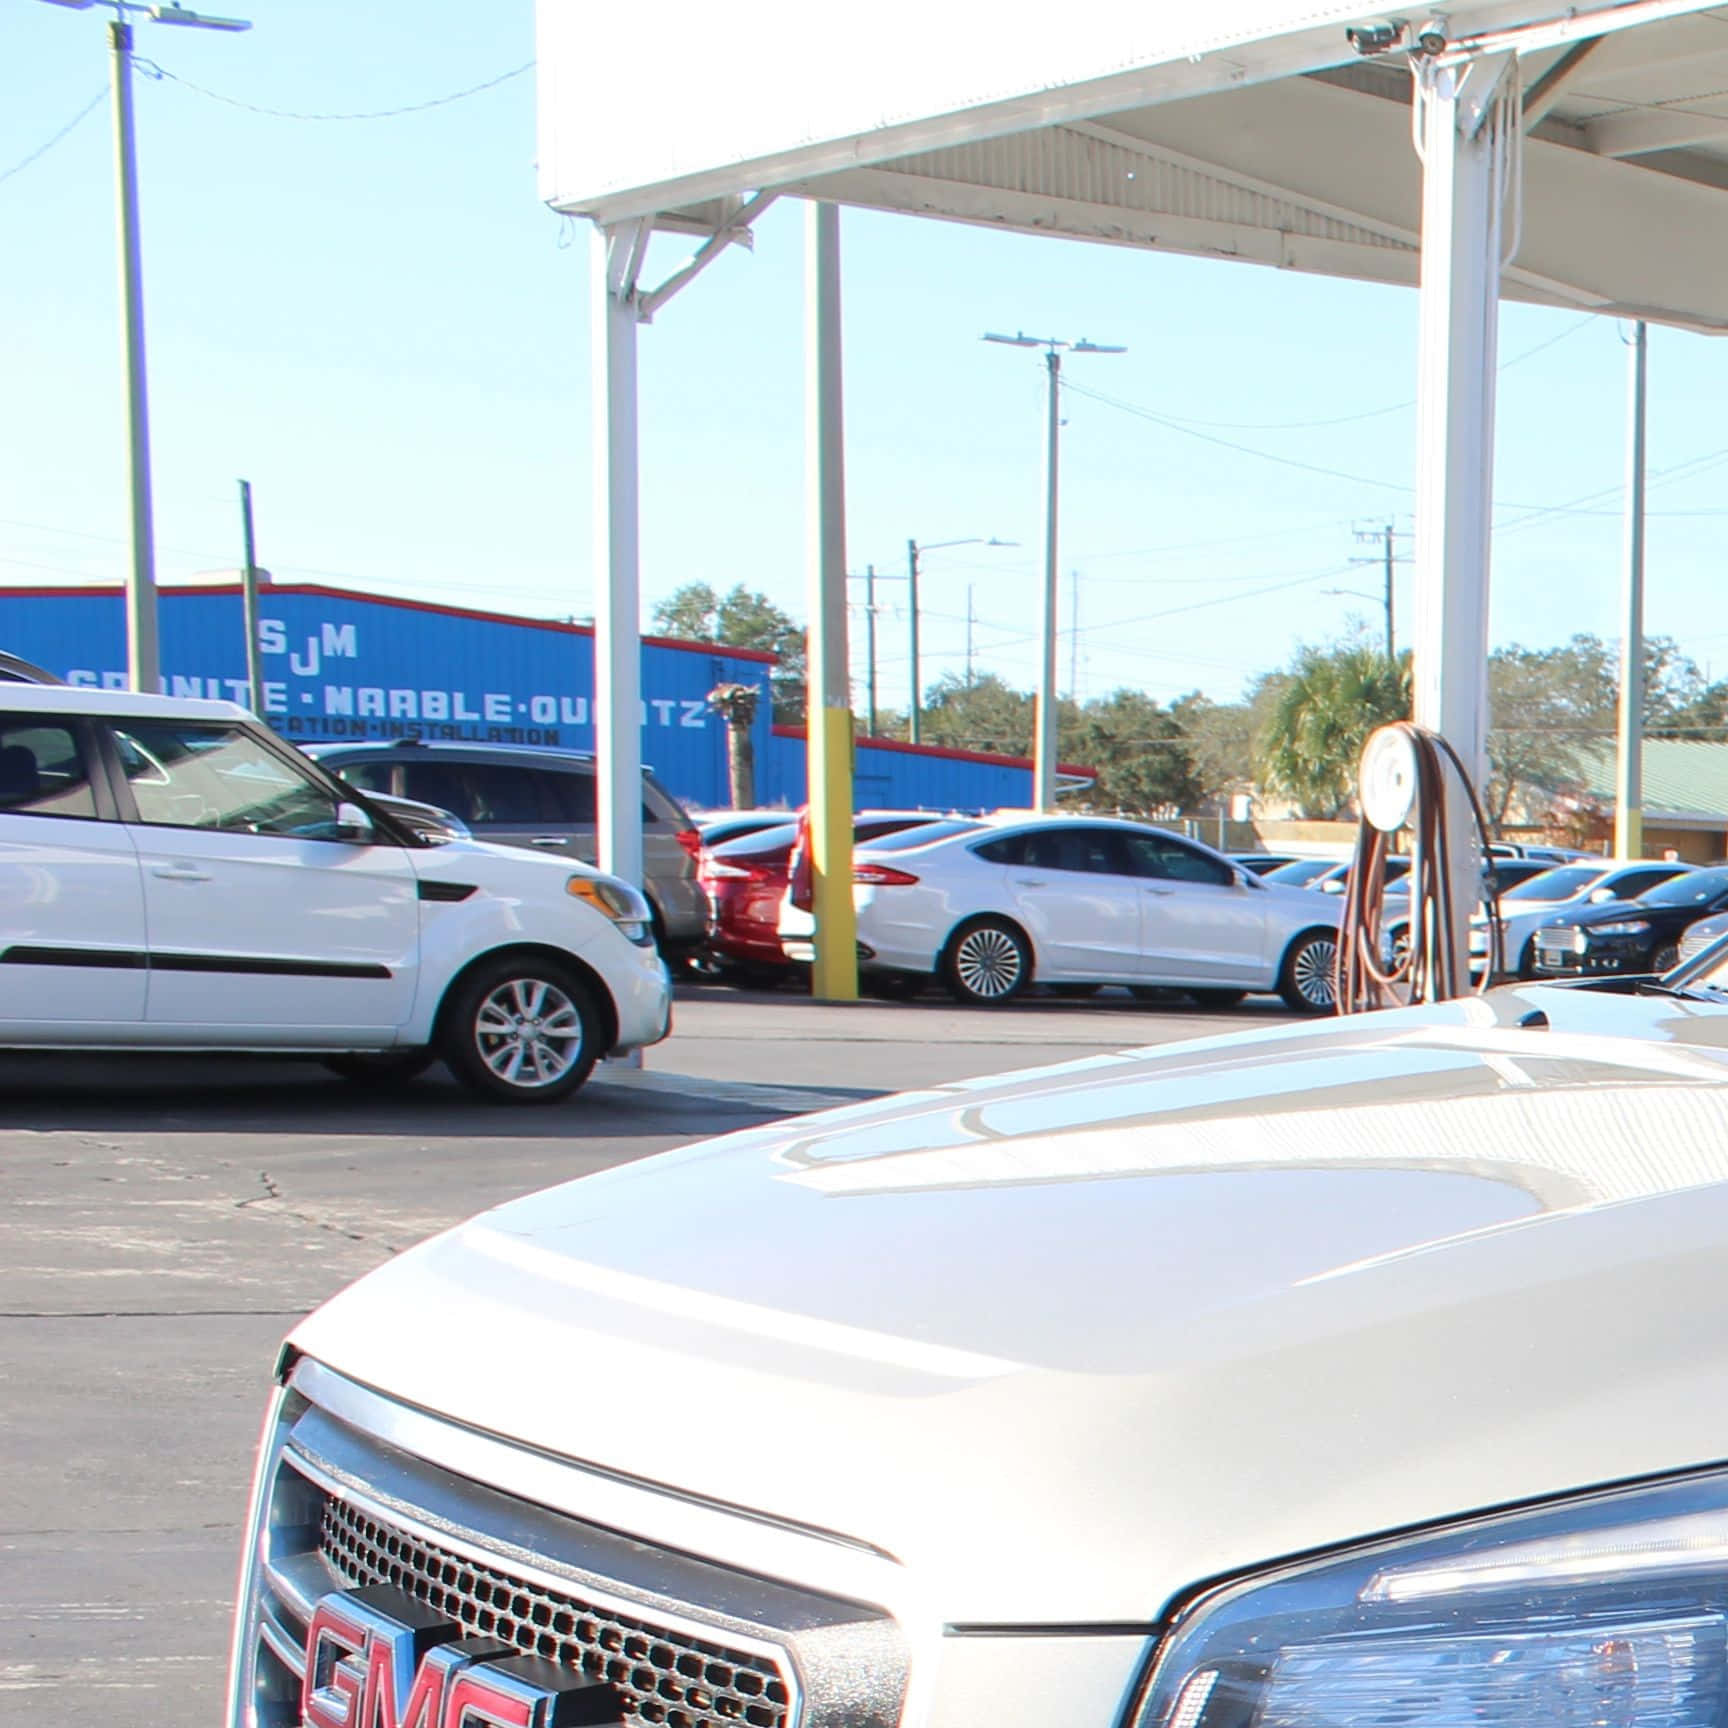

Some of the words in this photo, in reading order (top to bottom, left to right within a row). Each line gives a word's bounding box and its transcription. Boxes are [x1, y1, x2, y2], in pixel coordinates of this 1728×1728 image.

[258, 619, 357, 676] SJM
[66, 669, 288, 712] GRNITE
[324, 685, 512, 722] MARBLE
[530, 694, 706, 729] QUTZ
